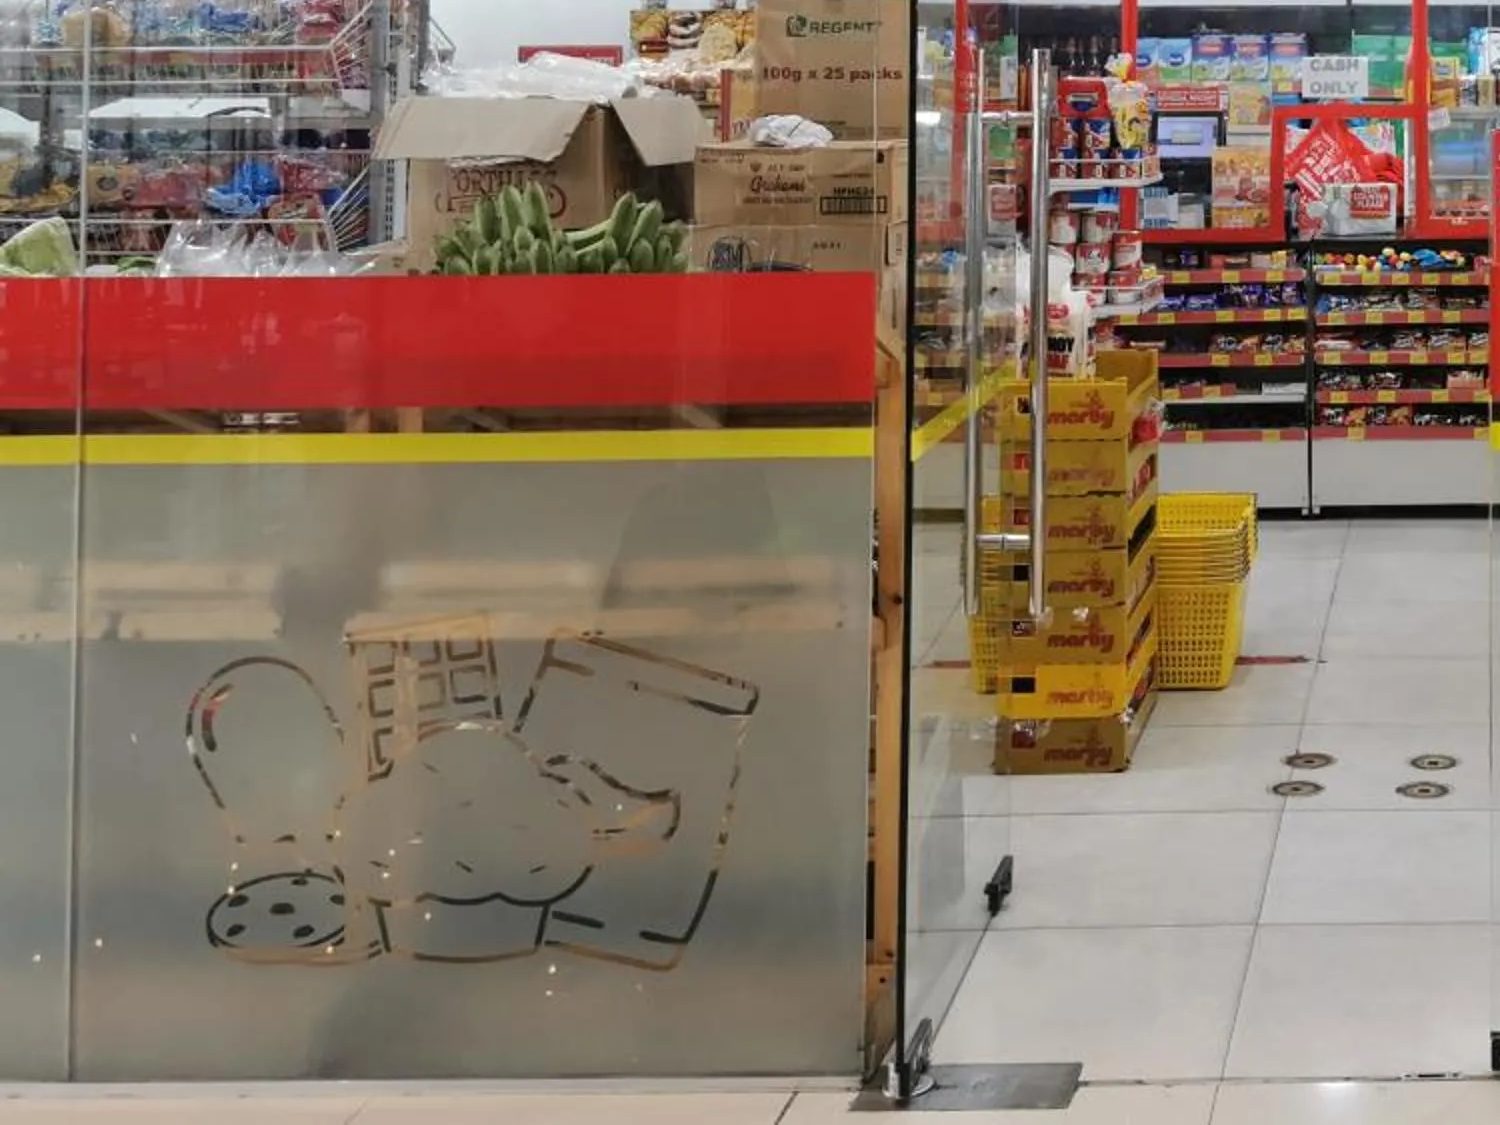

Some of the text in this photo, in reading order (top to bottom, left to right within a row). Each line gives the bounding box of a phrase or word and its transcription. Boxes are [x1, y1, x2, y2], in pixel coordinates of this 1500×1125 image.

[810, 21, 873, 34] REGENT
[1309, 58, 1360, 72] CASH
[763, 66, 903, 84] 100g x 25 packs
[1309, 81, 1359, 95] ONLY
